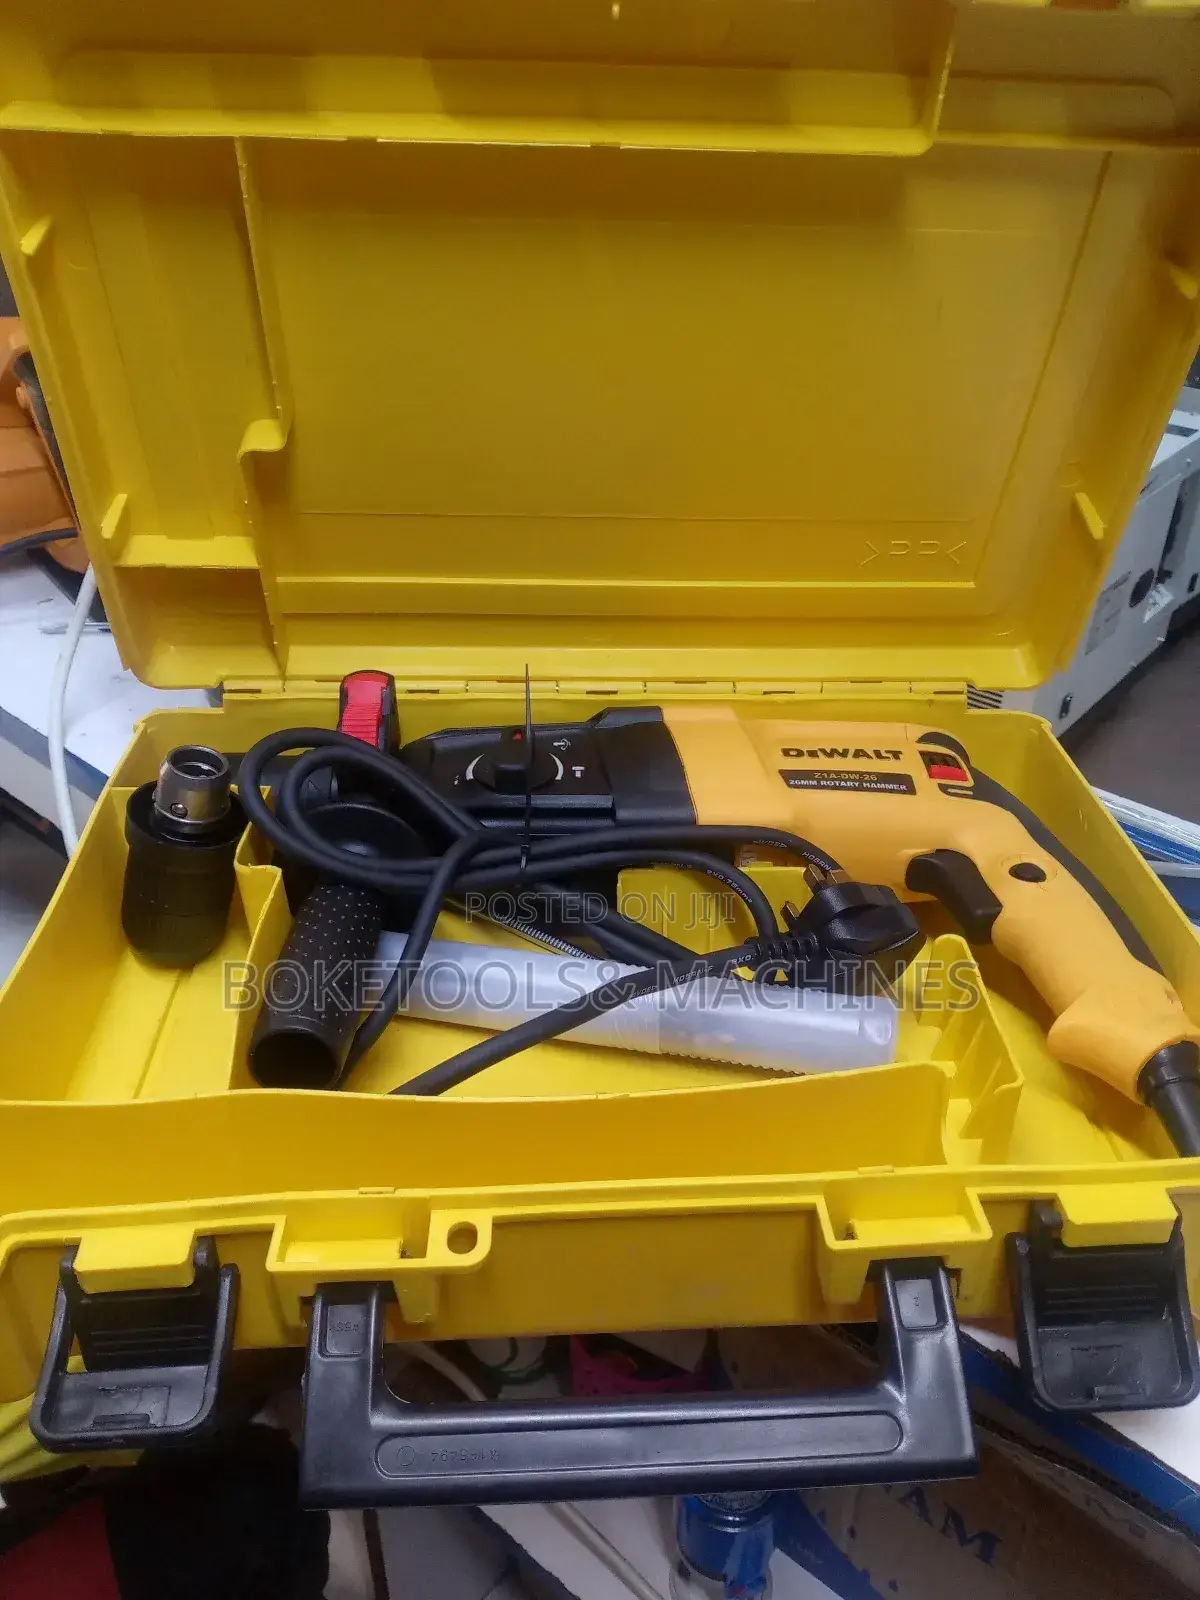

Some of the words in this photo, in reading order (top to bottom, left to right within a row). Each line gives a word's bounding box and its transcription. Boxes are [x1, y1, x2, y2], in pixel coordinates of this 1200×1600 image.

[813, 772, 878, 781] Z1A-DW-26
[789, 779, 818, 787] 26MM
[820, 780, 860, 788] ROTARY
[862, 782, 908, 791] HAMMER
[884, 1484, 1004, 1568] AM
